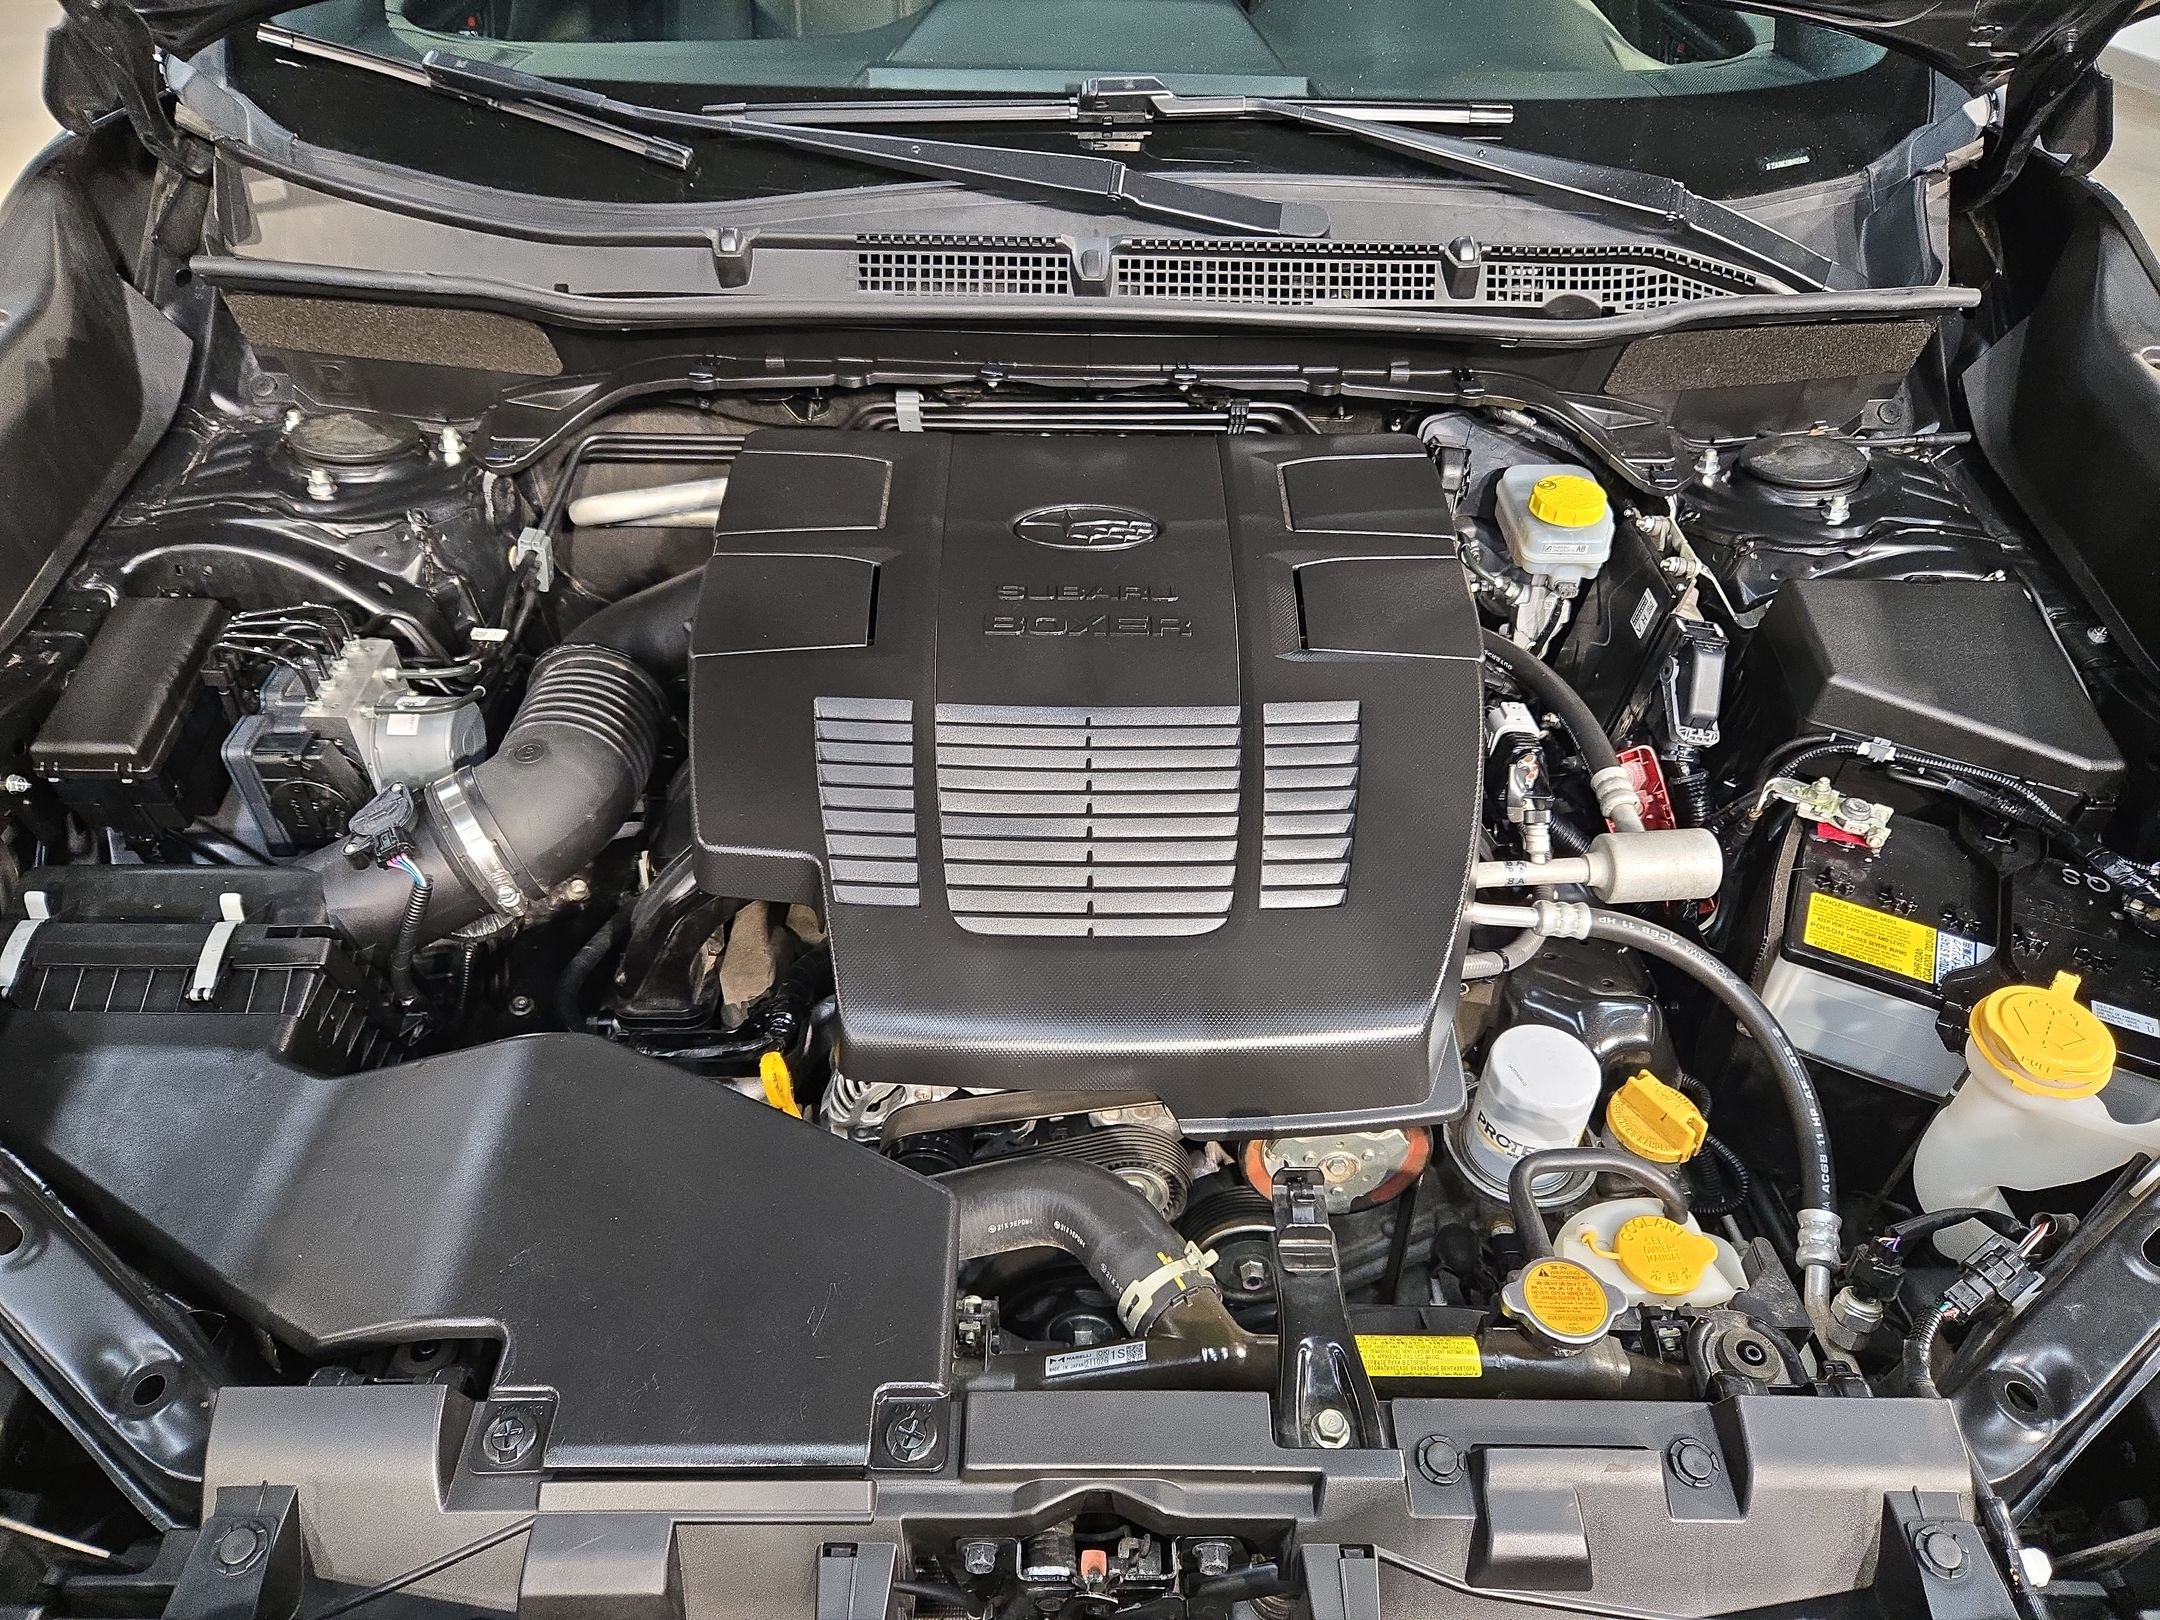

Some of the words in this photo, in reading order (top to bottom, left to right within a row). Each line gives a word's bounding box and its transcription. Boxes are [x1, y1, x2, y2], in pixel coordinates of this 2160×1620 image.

[997, 585, 1179, 601] SUBARU
[984, 615, 1193, 637] BOXER
[1814, 896, 1849, 910] DANGER
[1880, 916, 1897, 925] GASES
[1598, 916, 1616, 924] HP
[1620, 920, 1635, 930] 11
[1818, 916, 1830, 924] KEEP
[1846, 925, 1860, 934] CAPS
[1810, 922, 1844, 936] POISON
[1846, 933, 1867, 944] CAUSES
[1684, 944, 1730, 979] YOKOHAMA
[1875, 958, 1903, 972] CHILDREN
[2147, 1025, 2154, 1034] U
[1810, 1108, 1822, 1127] HP
[1816, 1133, 1826, 1147] 11
[1620, 1217, 1685, 1241] COOLANT
[1644, 1236, 1664, 1246] SEE
[1646, 1252, 1682, 1263] MANUAL
